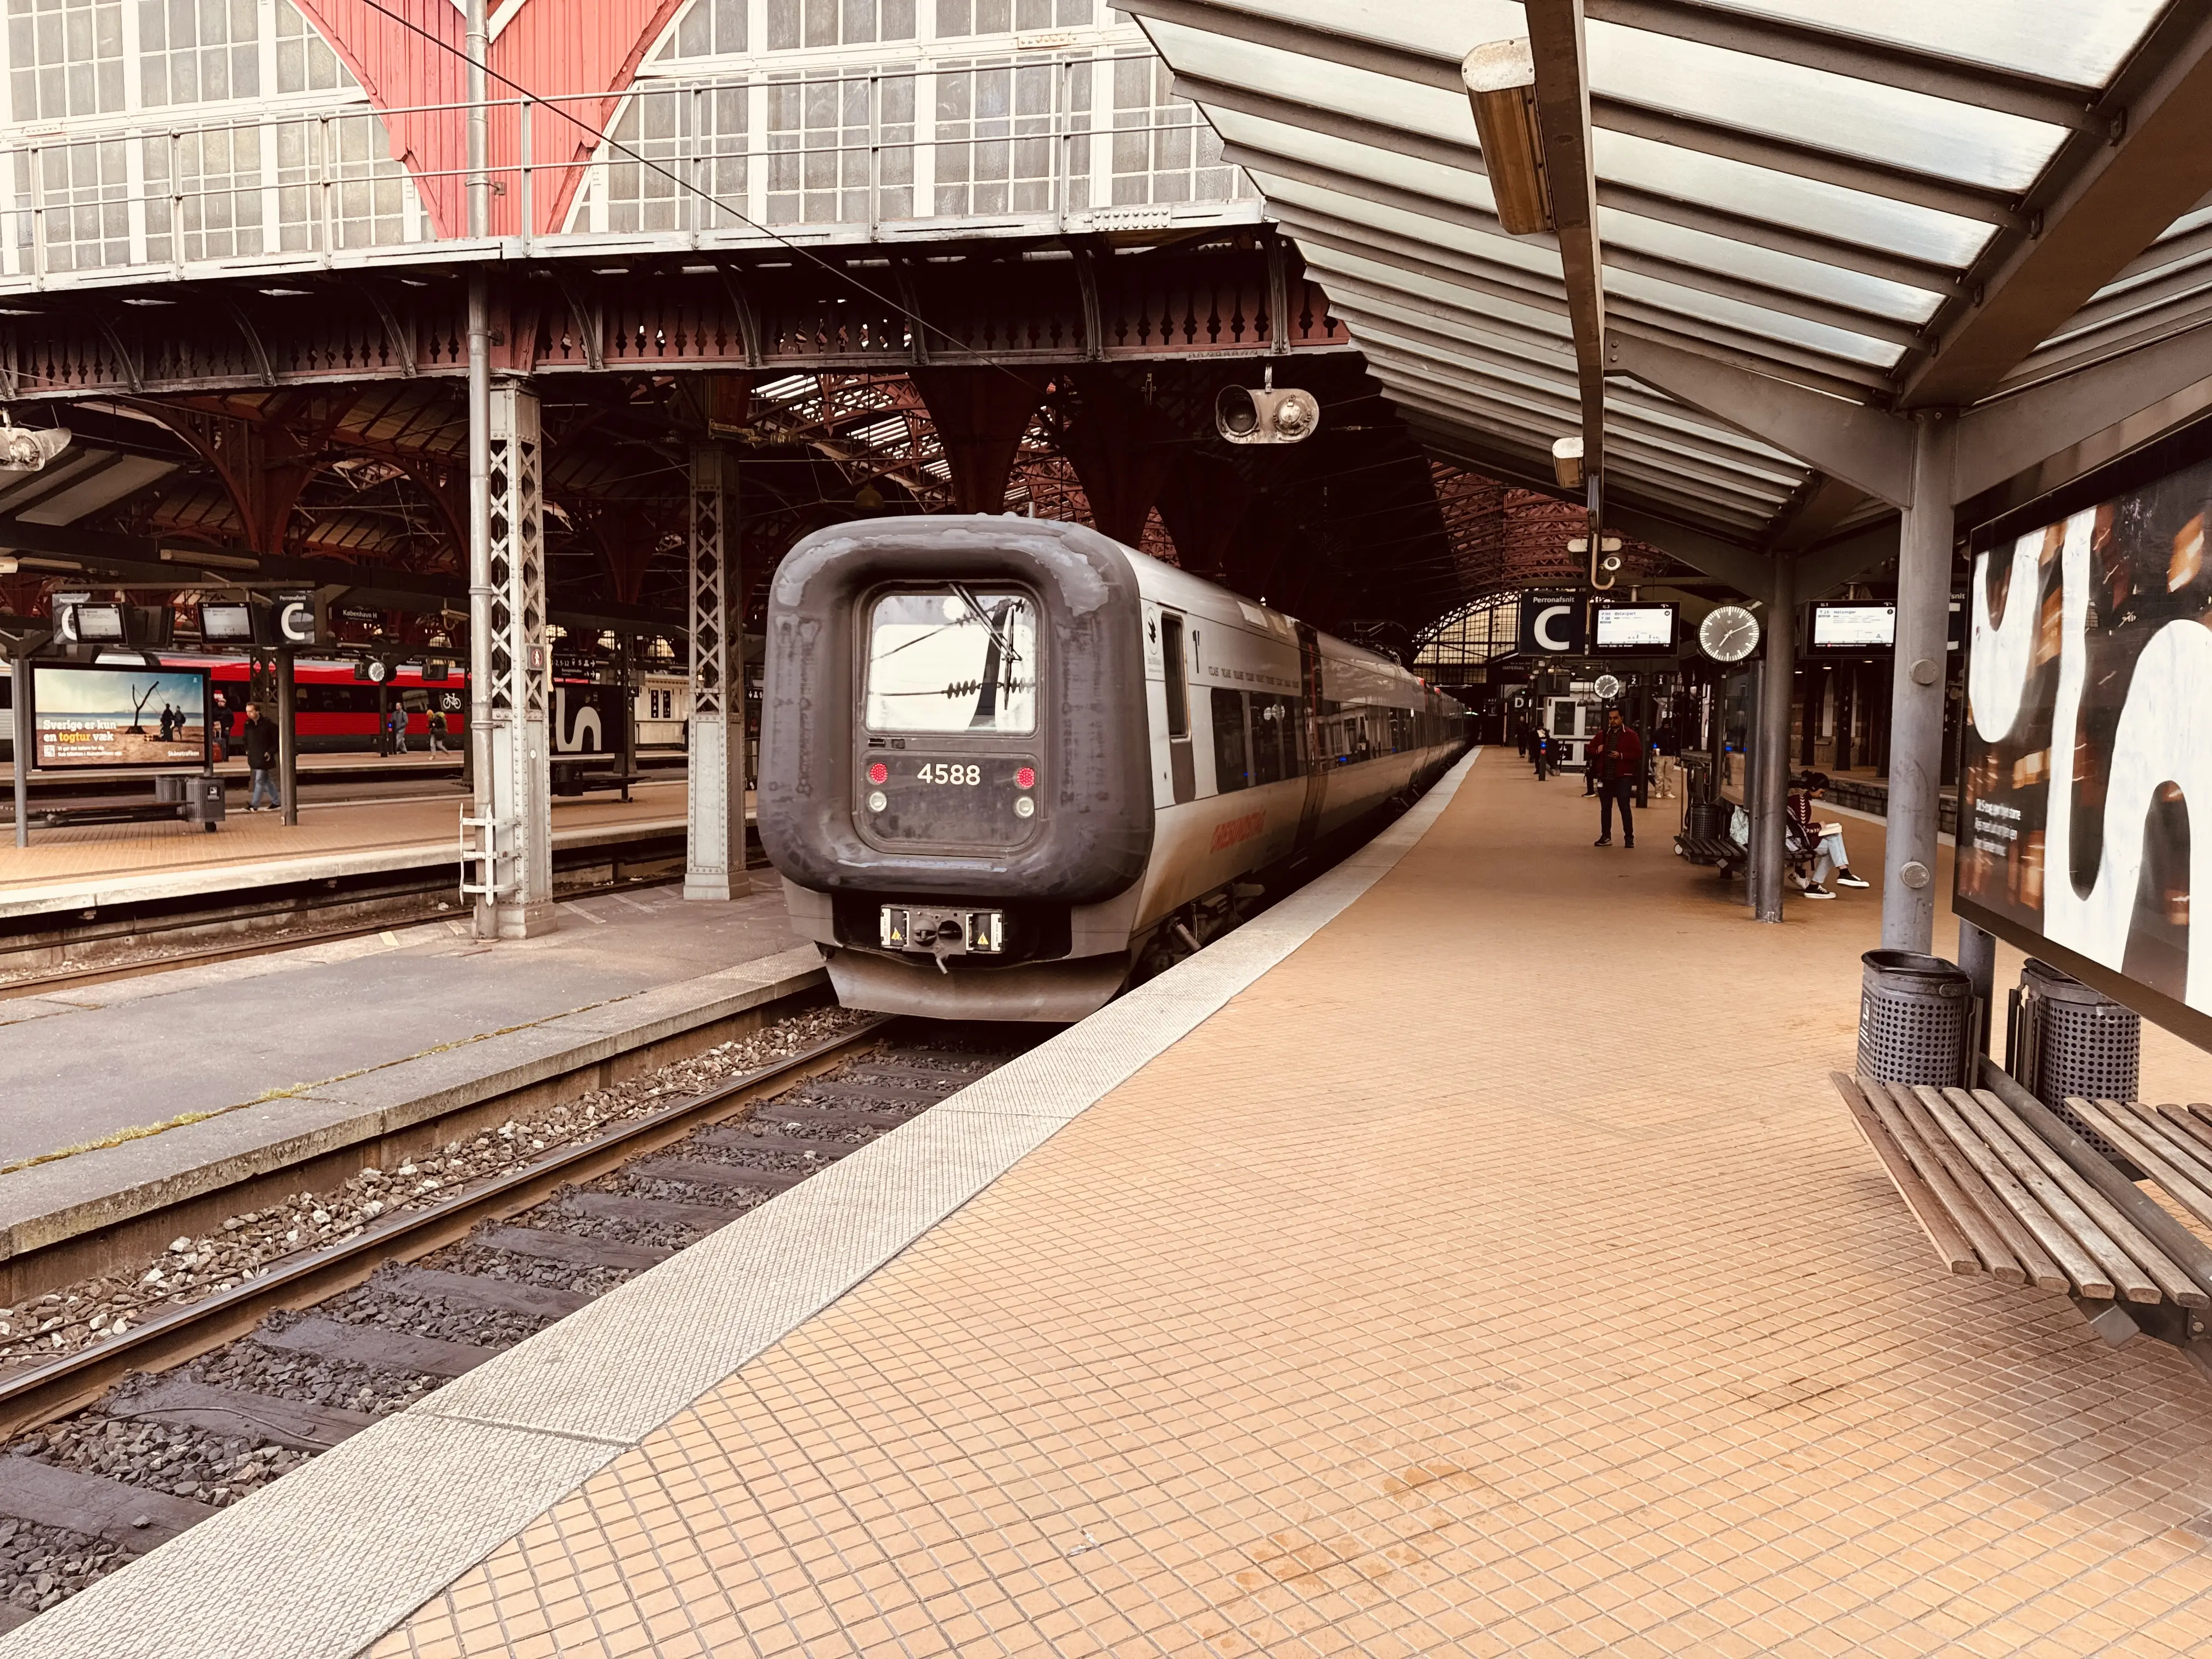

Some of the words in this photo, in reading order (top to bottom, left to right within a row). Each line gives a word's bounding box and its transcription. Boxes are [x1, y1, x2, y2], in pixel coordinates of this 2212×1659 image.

[343, 610, 372, 618] København
[281, 602, 305, 640] C
[1534, 606, 1571, 651] C
[1514, 697, 1524, 708] D
[43, 719, 82, 732] Sverige
[84, 721, 95, 730] er
[97, 719, 117, 730] kun
[43, 733, 57, 742] en
[59, 732, 90, 743] togtur
[92, 731, 114, 741] væk
[917, 763, 980, 786] 4588
